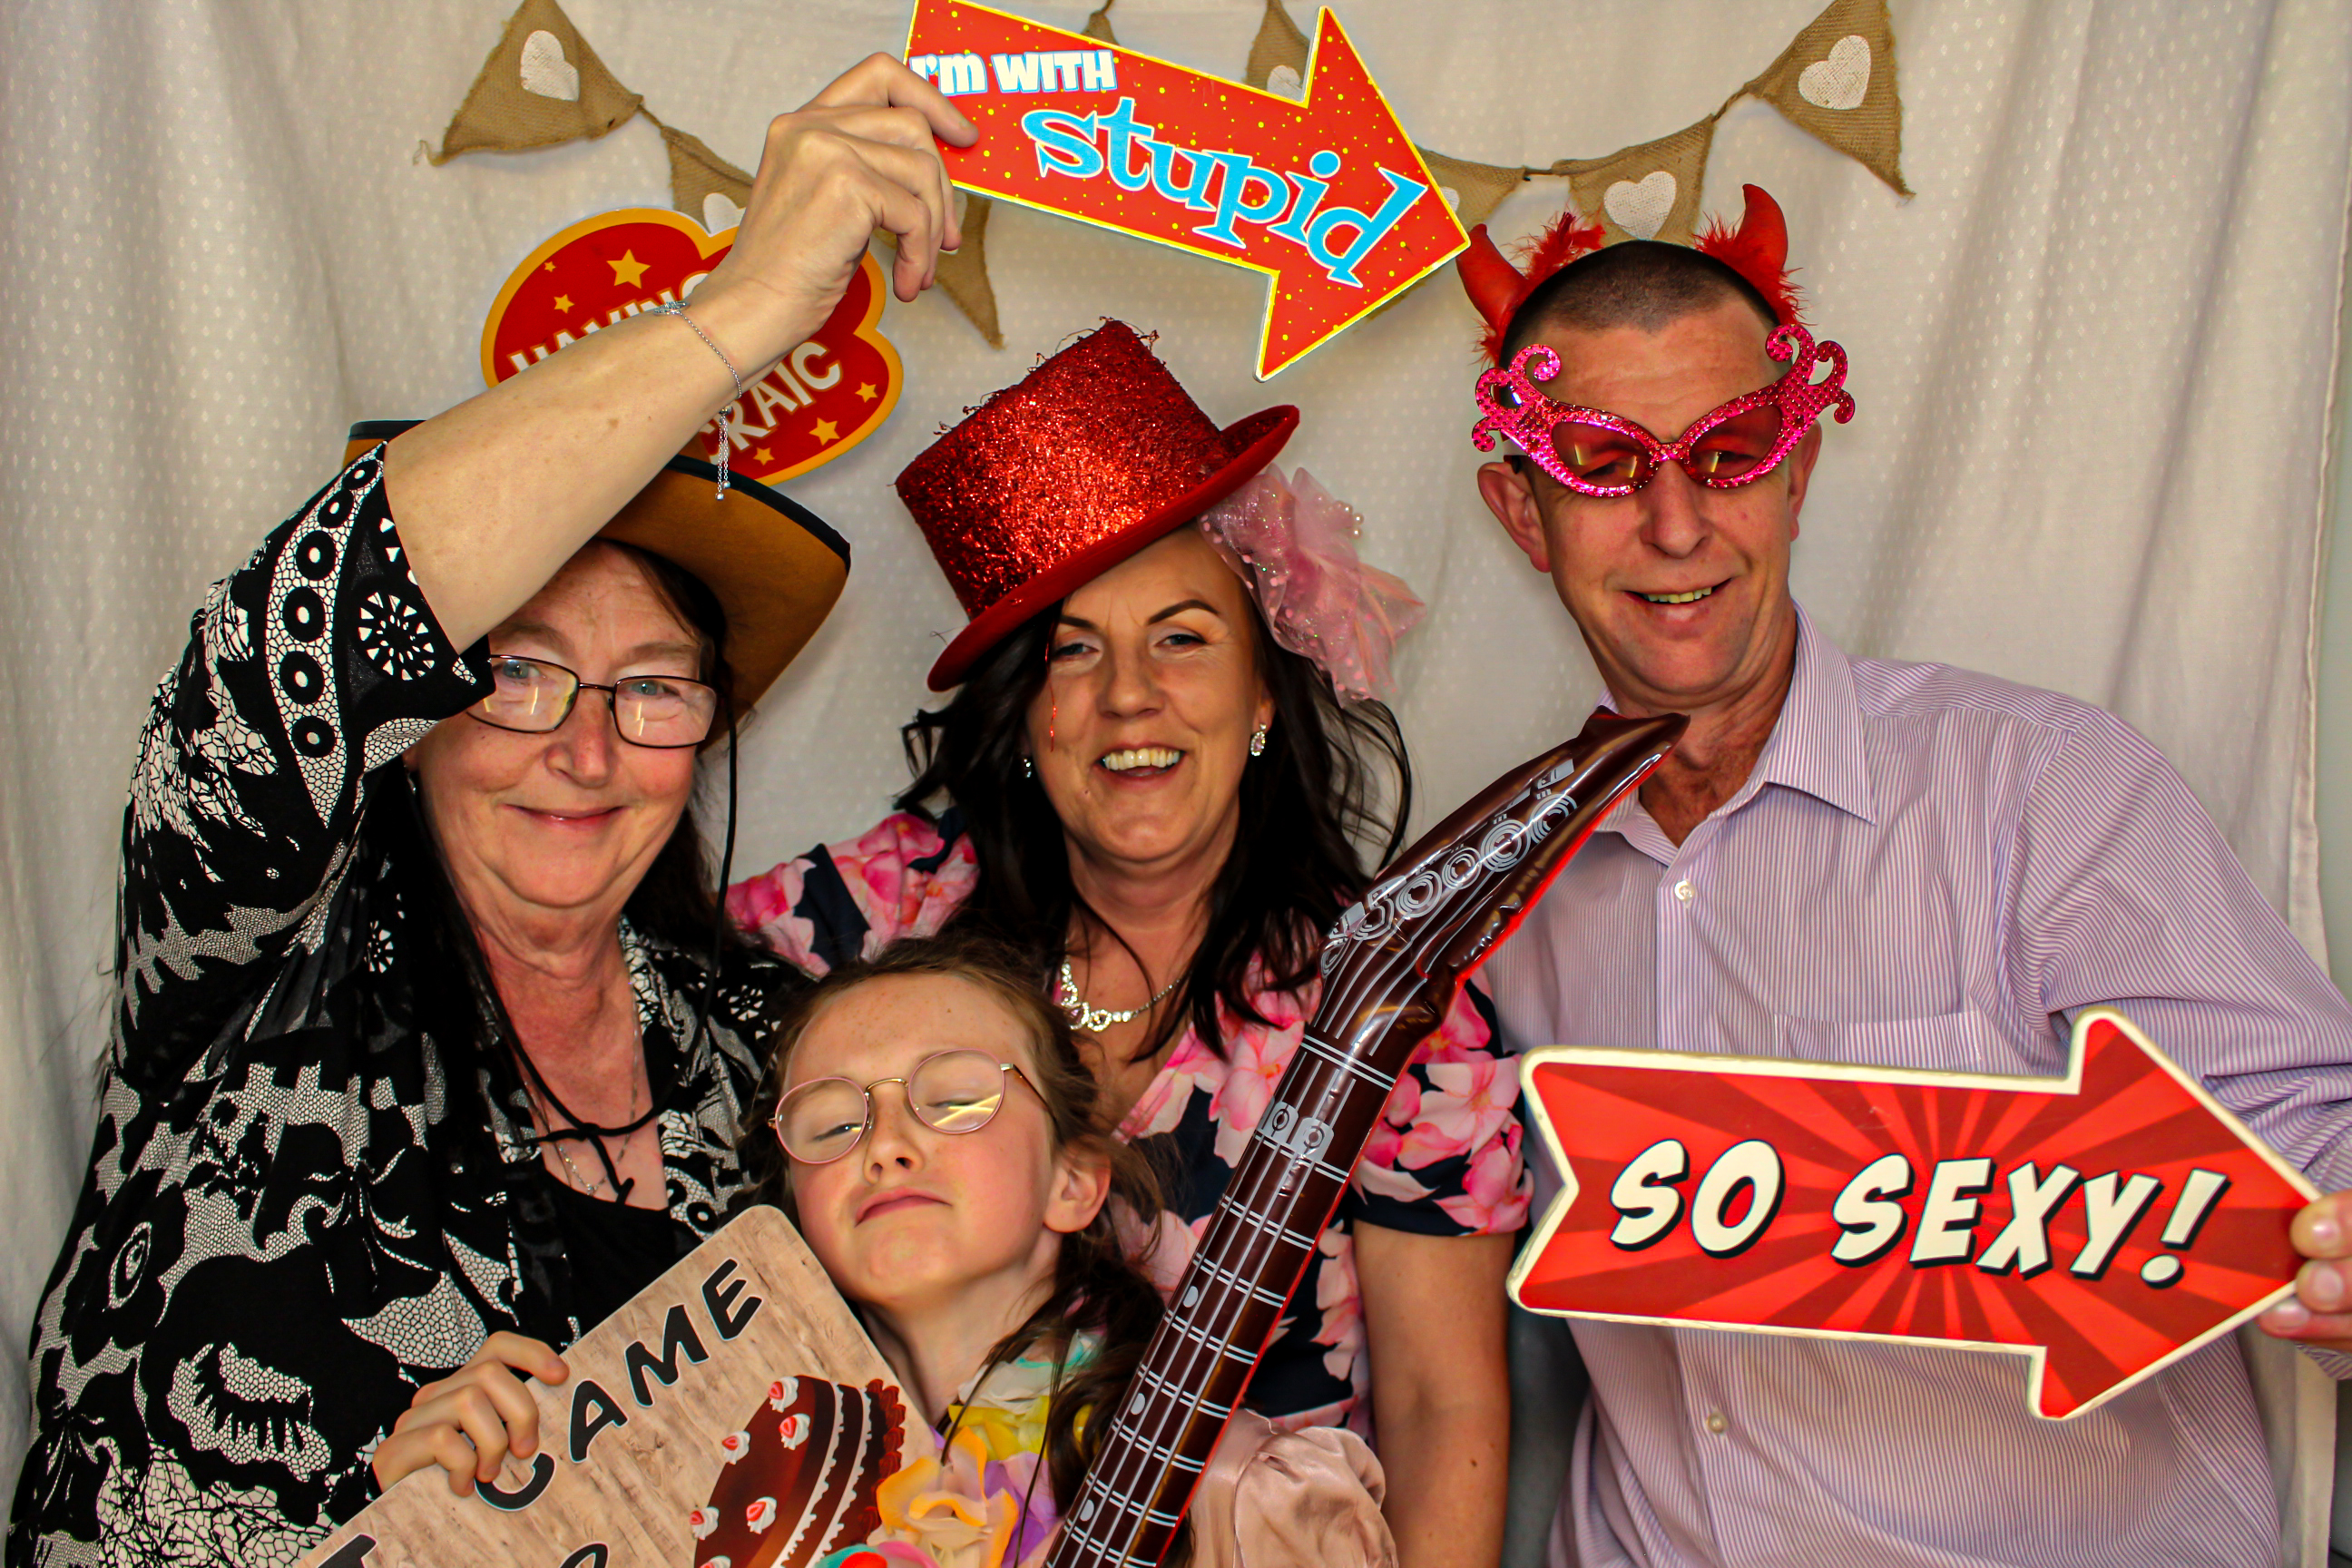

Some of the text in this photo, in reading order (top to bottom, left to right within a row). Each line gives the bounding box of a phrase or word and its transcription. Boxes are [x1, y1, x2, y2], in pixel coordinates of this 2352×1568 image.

[990, 50, 1117, 93] WITH
[1609, 1139, 2228, 1289] SO SEXY!
